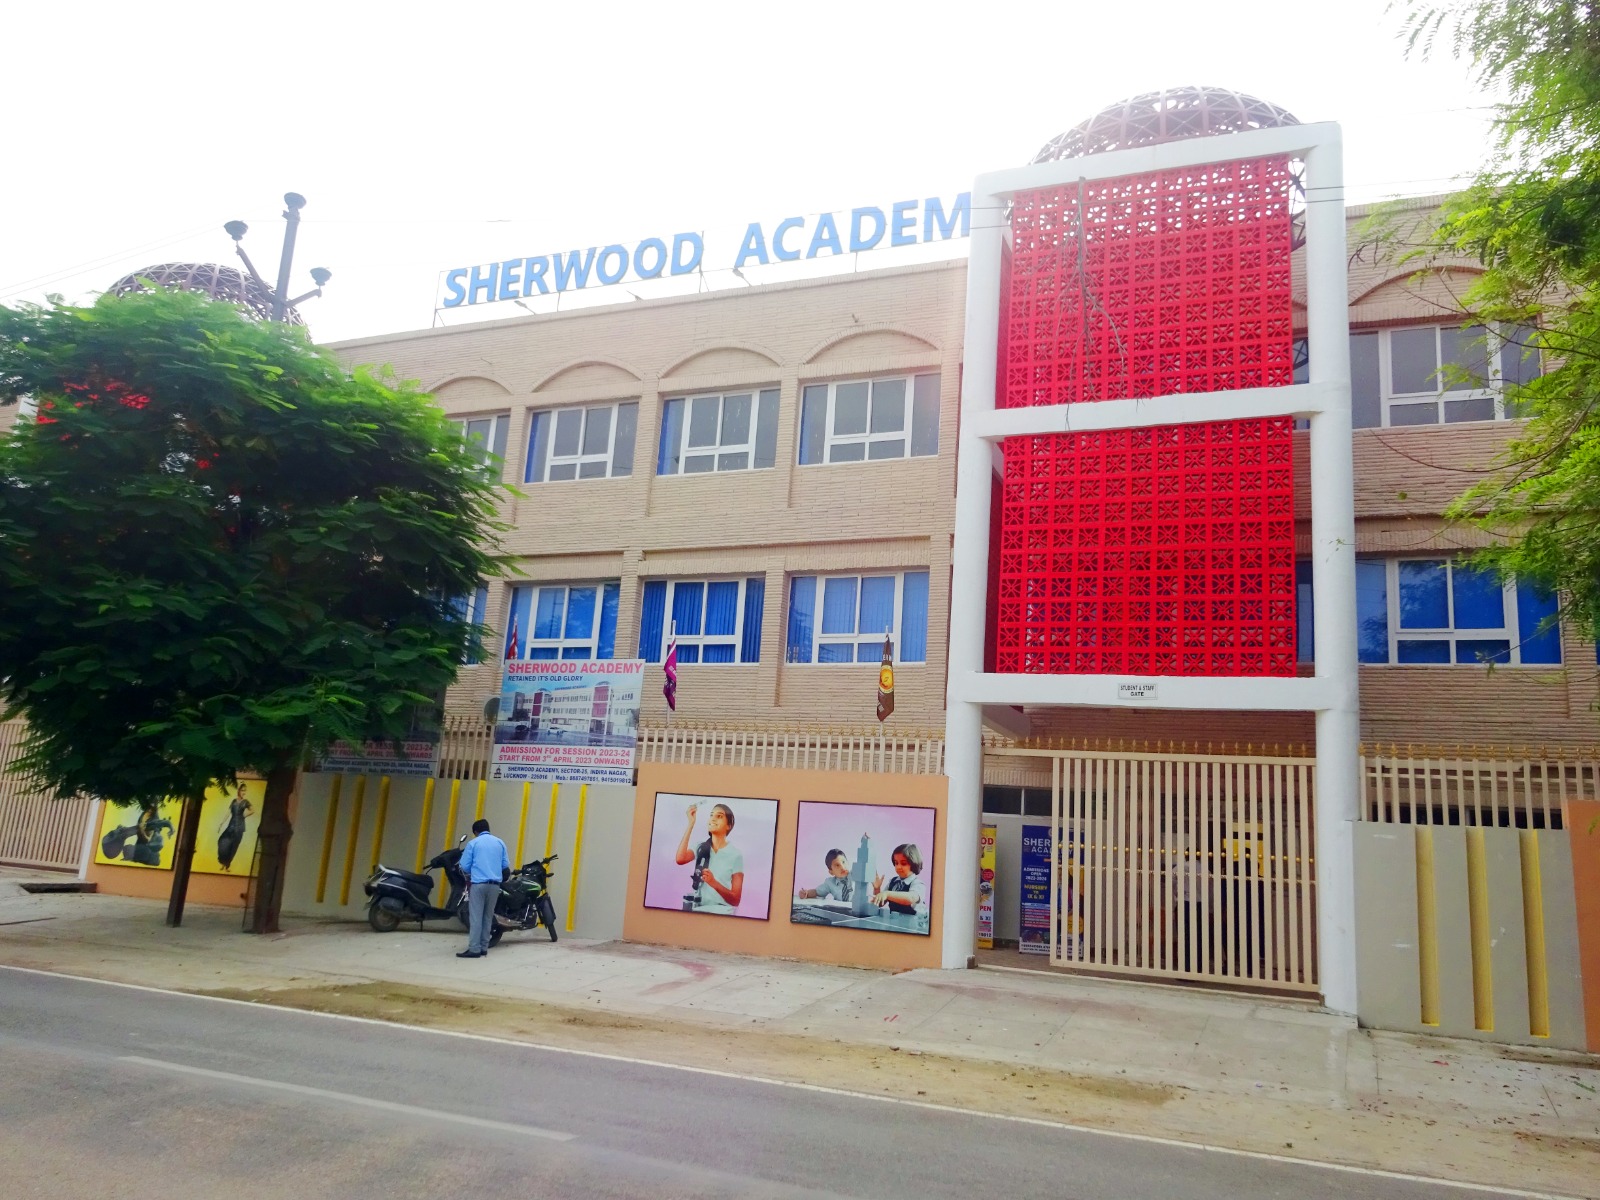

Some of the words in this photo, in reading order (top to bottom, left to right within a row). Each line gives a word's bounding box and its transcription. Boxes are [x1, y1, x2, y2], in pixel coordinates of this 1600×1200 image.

[442, 231, 704, 308] SHERWOOD
[734, 191, 972, 268] ACADEM
[508, 663, 577, 674] SHERWOOD
[580, 662, 643, 674] ACADEMY
[500, 746, 542, 754] ADMISSION
[562, 748, 597, 756] SESSION
[599, 749, 630, 757] 2023-24
[594, 758, 630, 766] ONWARDS
